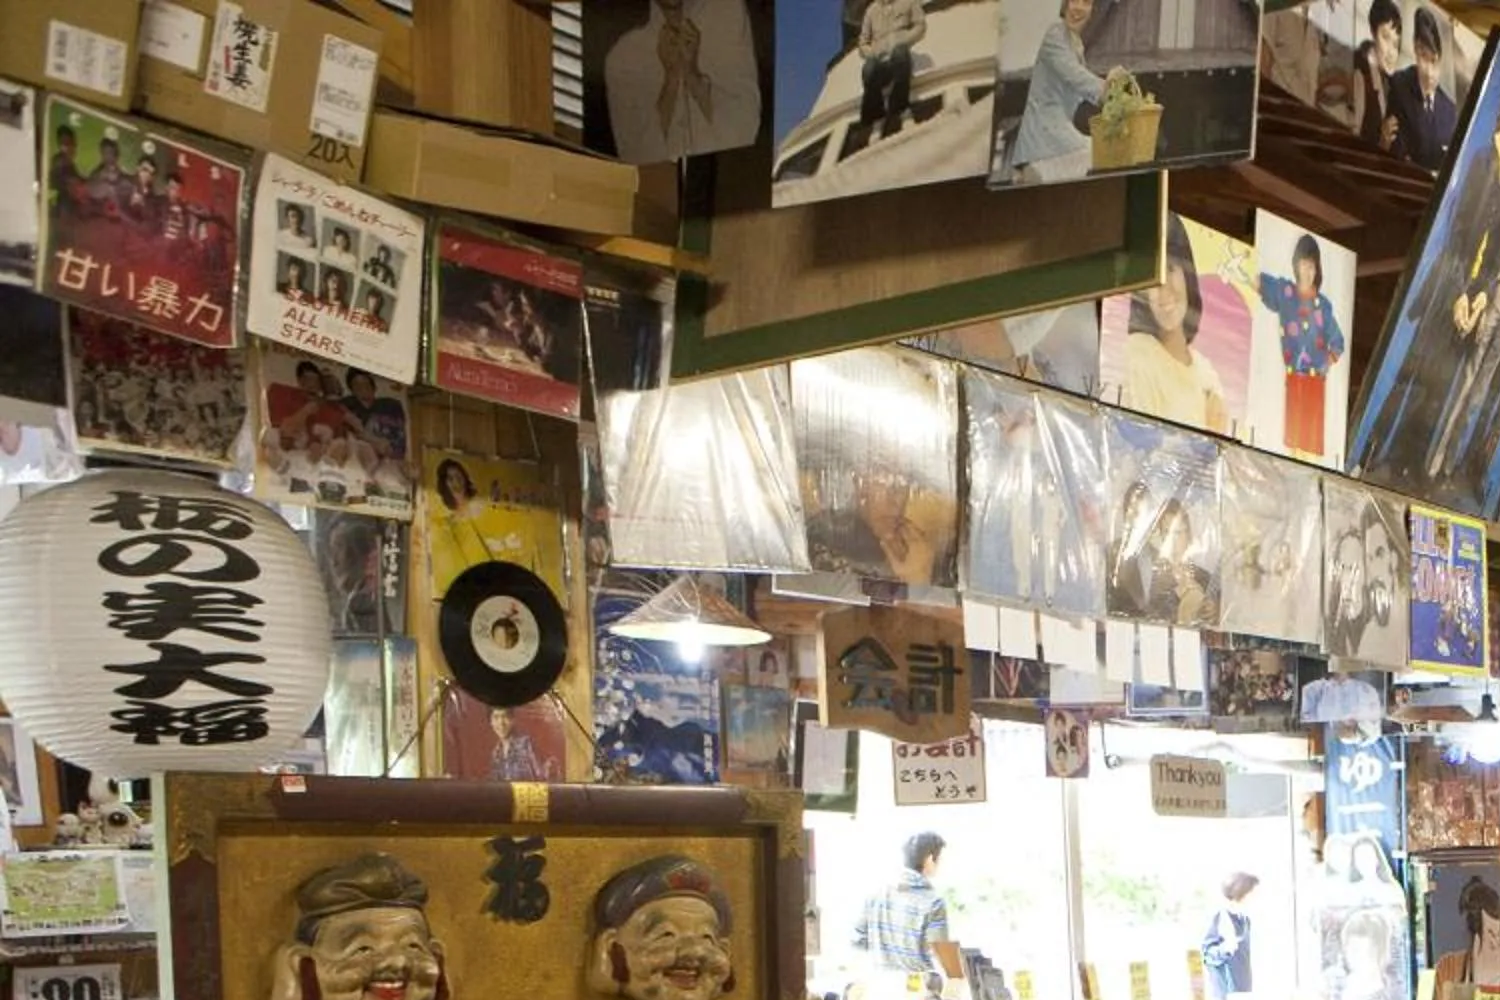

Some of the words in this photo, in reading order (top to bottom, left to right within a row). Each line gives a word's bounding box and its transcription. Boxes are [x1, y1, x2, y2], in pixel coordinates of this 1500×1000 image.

[55, 248, 224, 331] 甘い暴力
[280, 322, 344, 355] STARS
[285, 306, 318, 330] ALL
[89, 490, 274, 746] 栃の実大福
[838, 635, 963, 715] 会計
[898, 768, 959, 783] こちらへ
